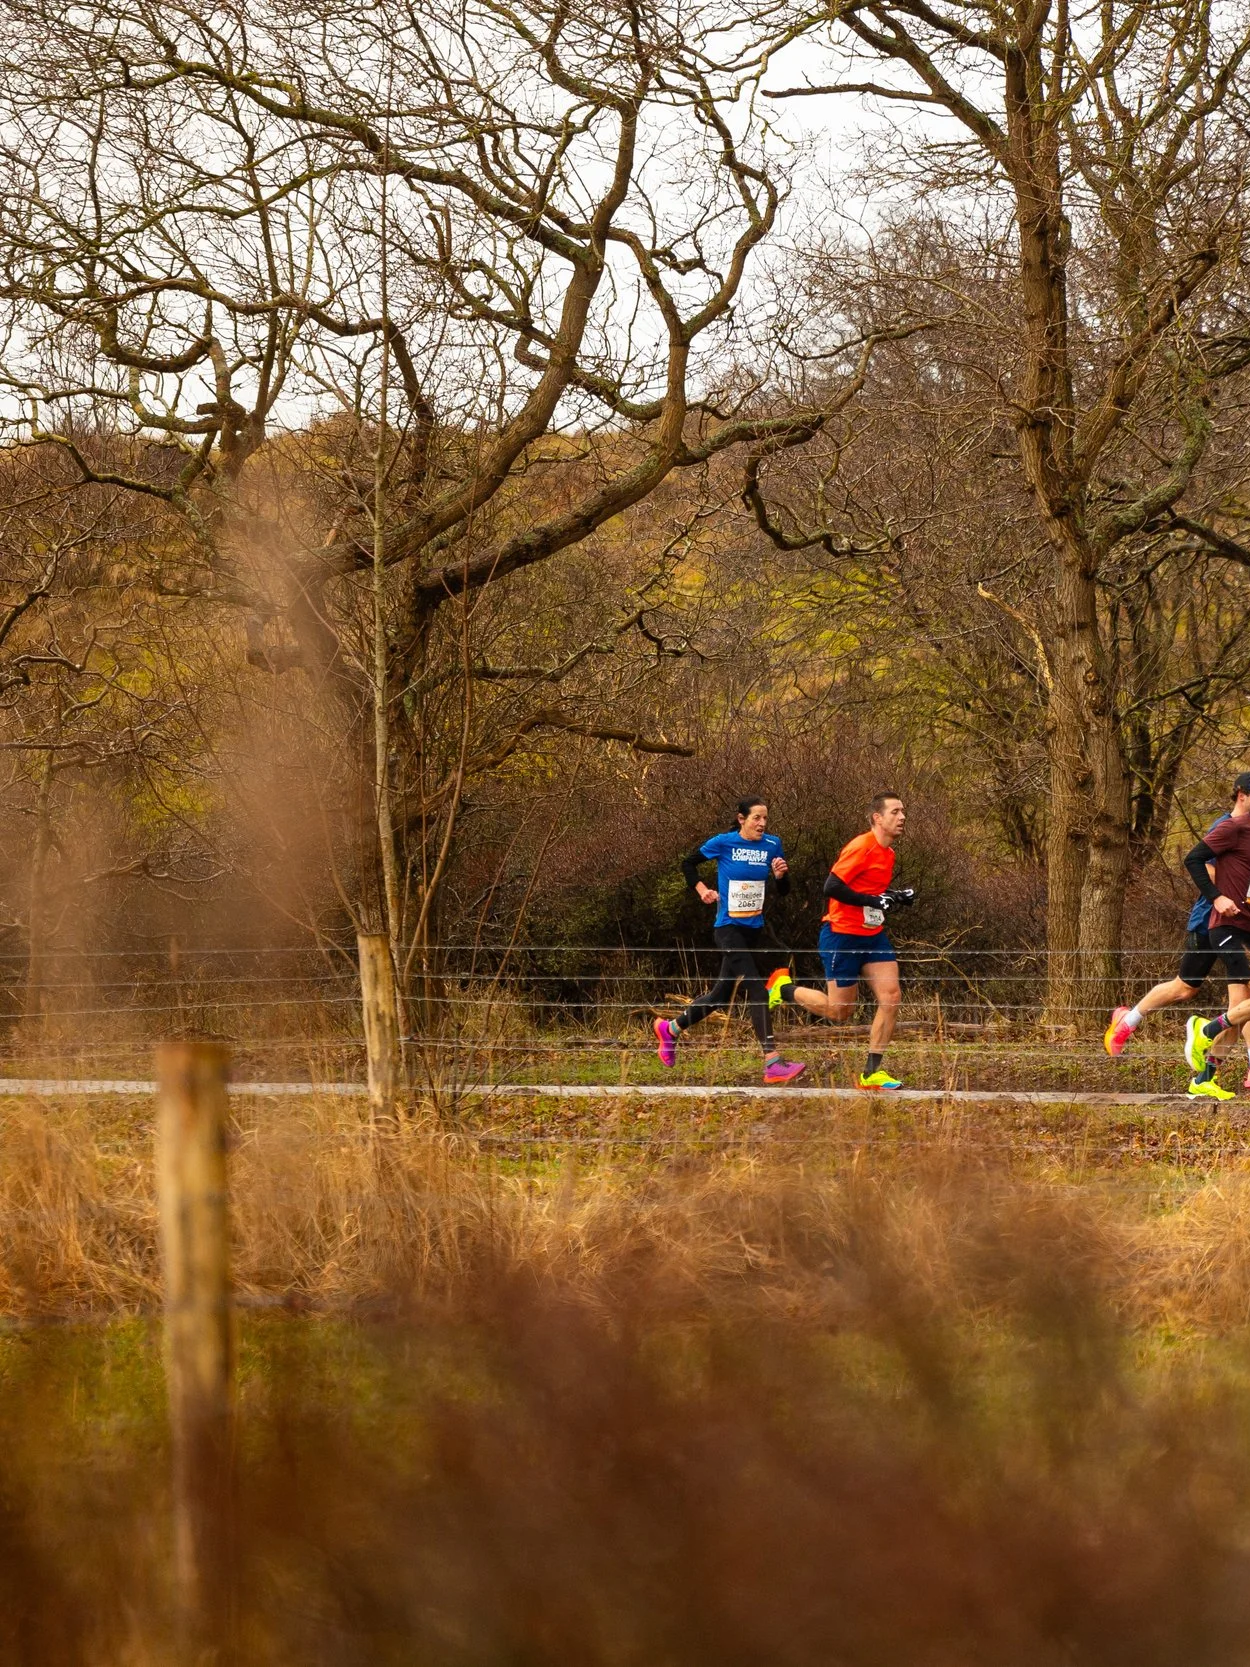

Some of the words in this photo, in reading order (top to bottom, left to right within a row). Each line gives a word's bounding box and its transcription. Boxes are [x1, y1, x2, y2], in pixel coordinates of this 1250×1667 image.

[732, 848, 760, 857] LOPERS
[732, 854, 761, 862] COMPANY
[738, 900, 756, 908] 2065
